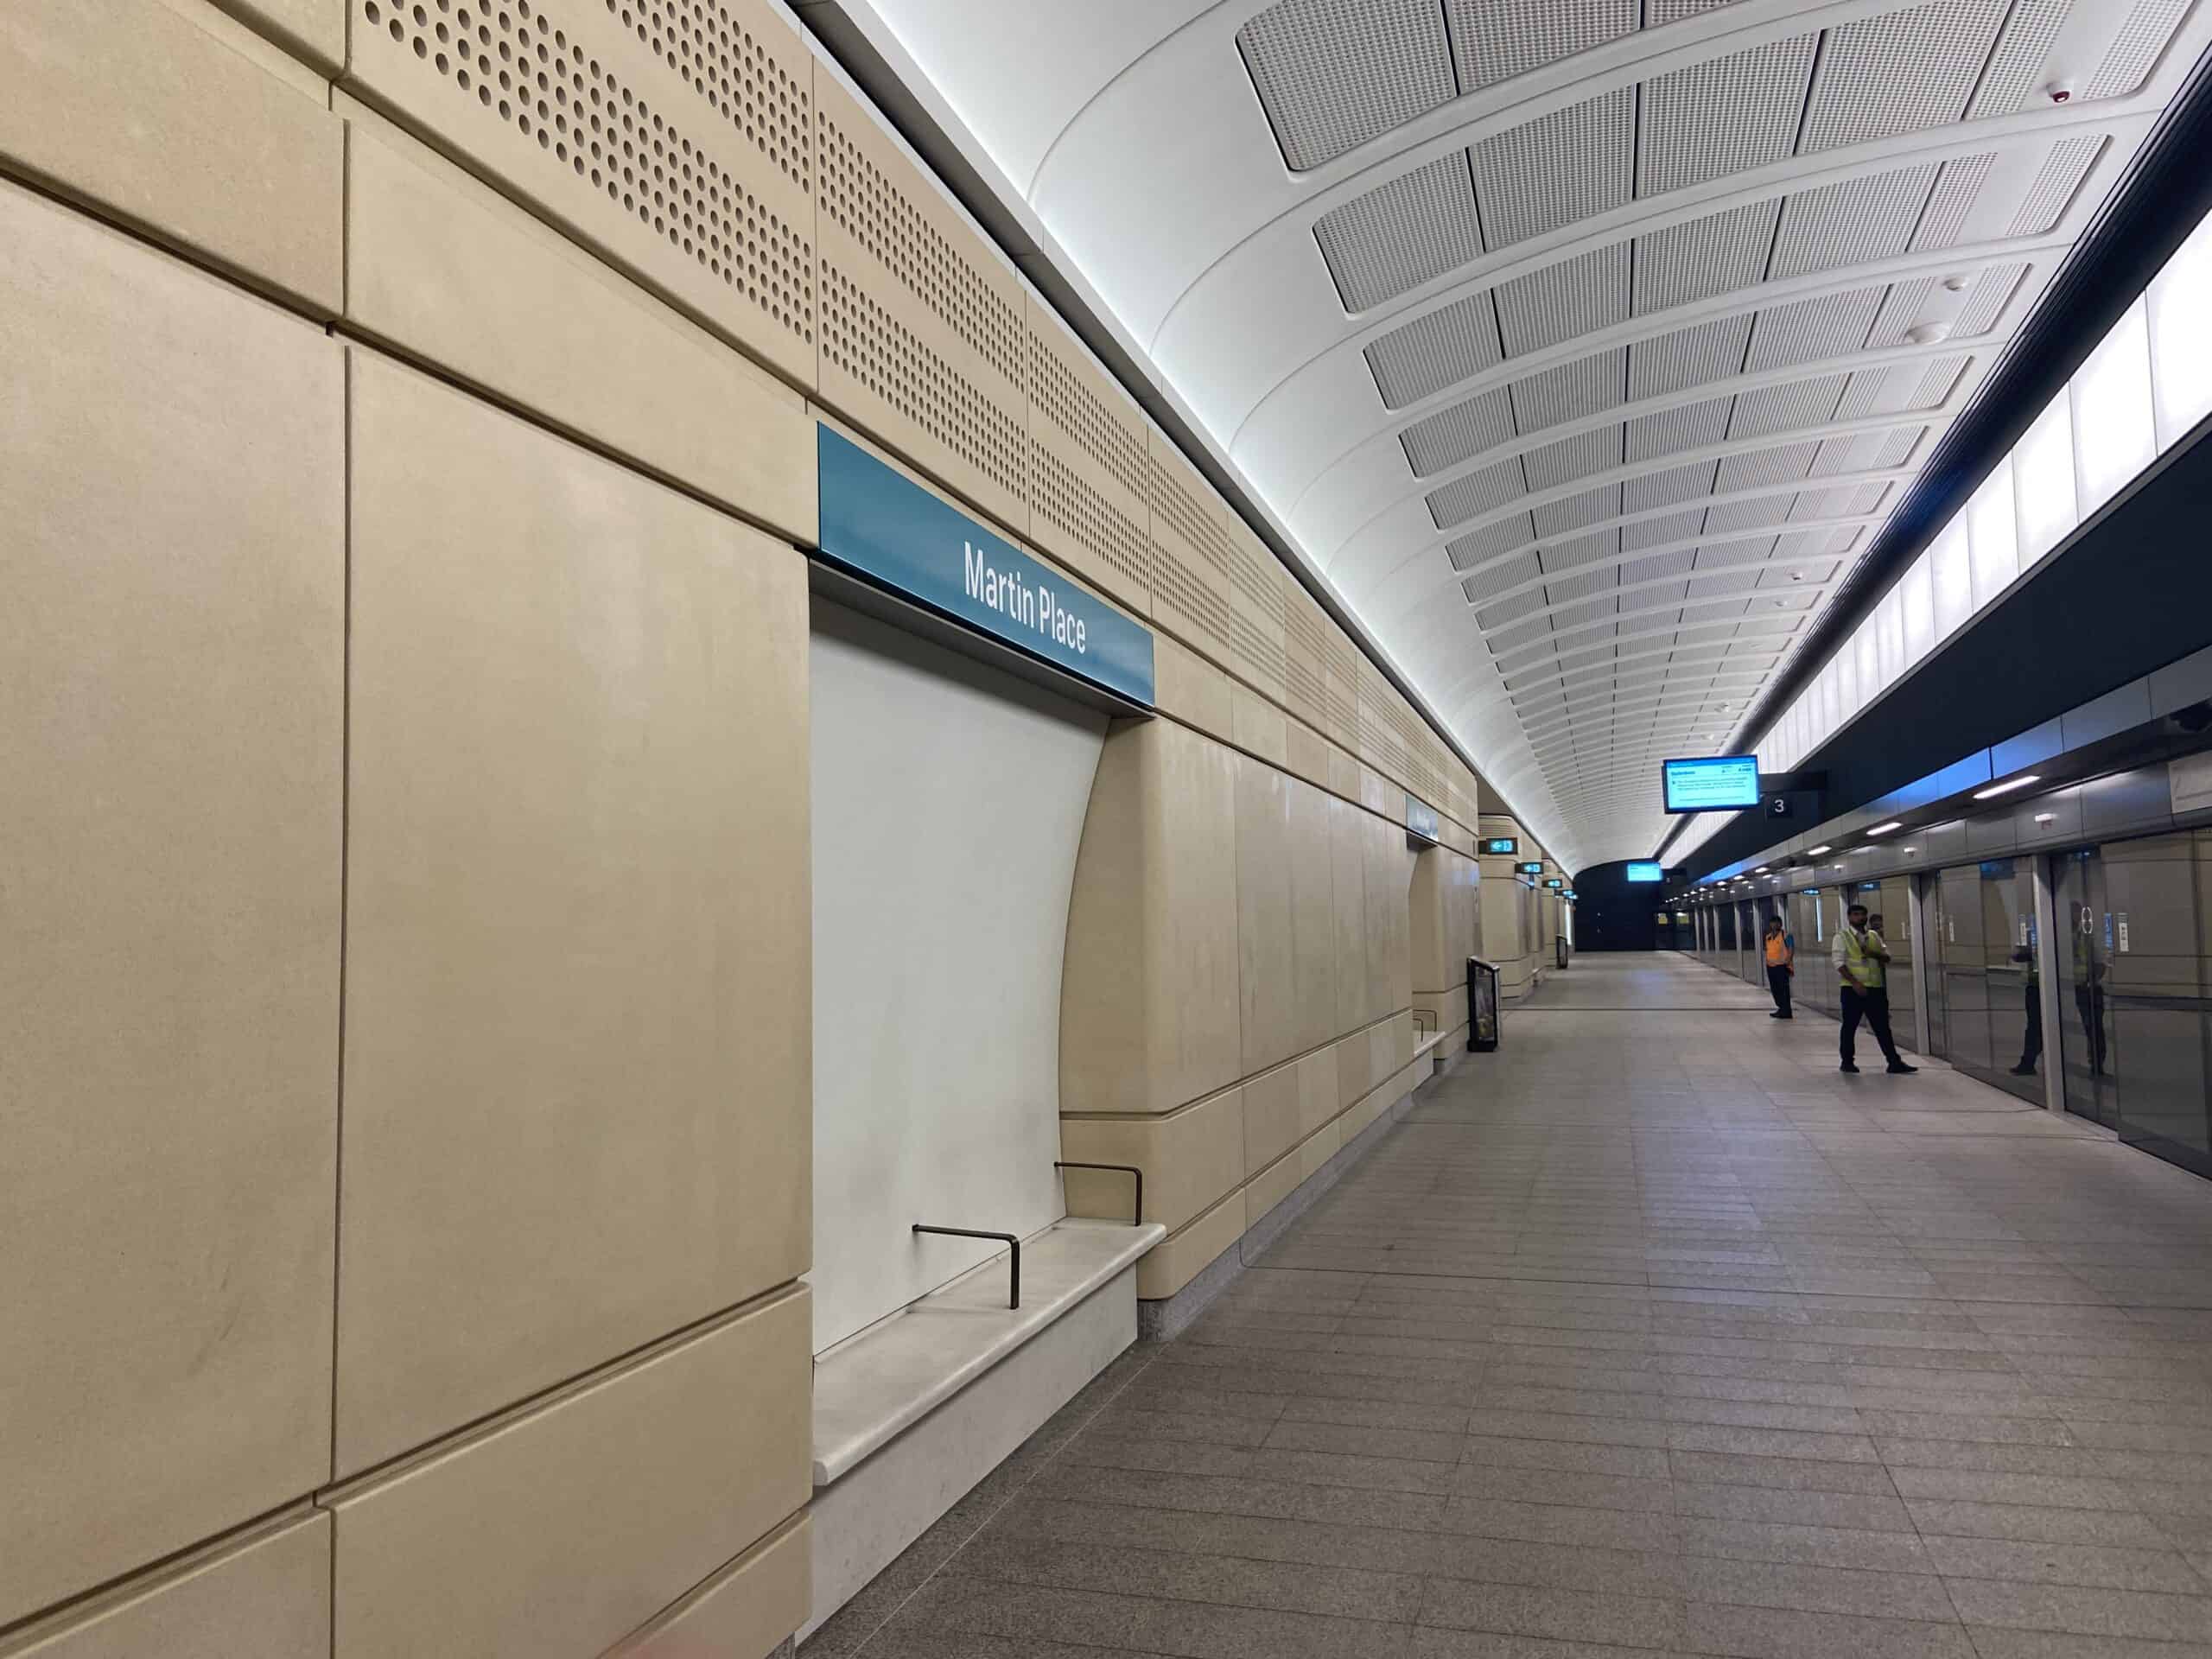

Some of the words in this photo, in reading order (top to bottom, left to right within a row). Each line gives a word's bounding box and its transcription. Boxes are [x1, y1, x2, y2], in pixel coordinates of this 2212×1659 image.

[964, 541, 1034, 628] Martin
[1039, 586, 1086, 654] Place
[1775, 799, 1784, 812] 3
